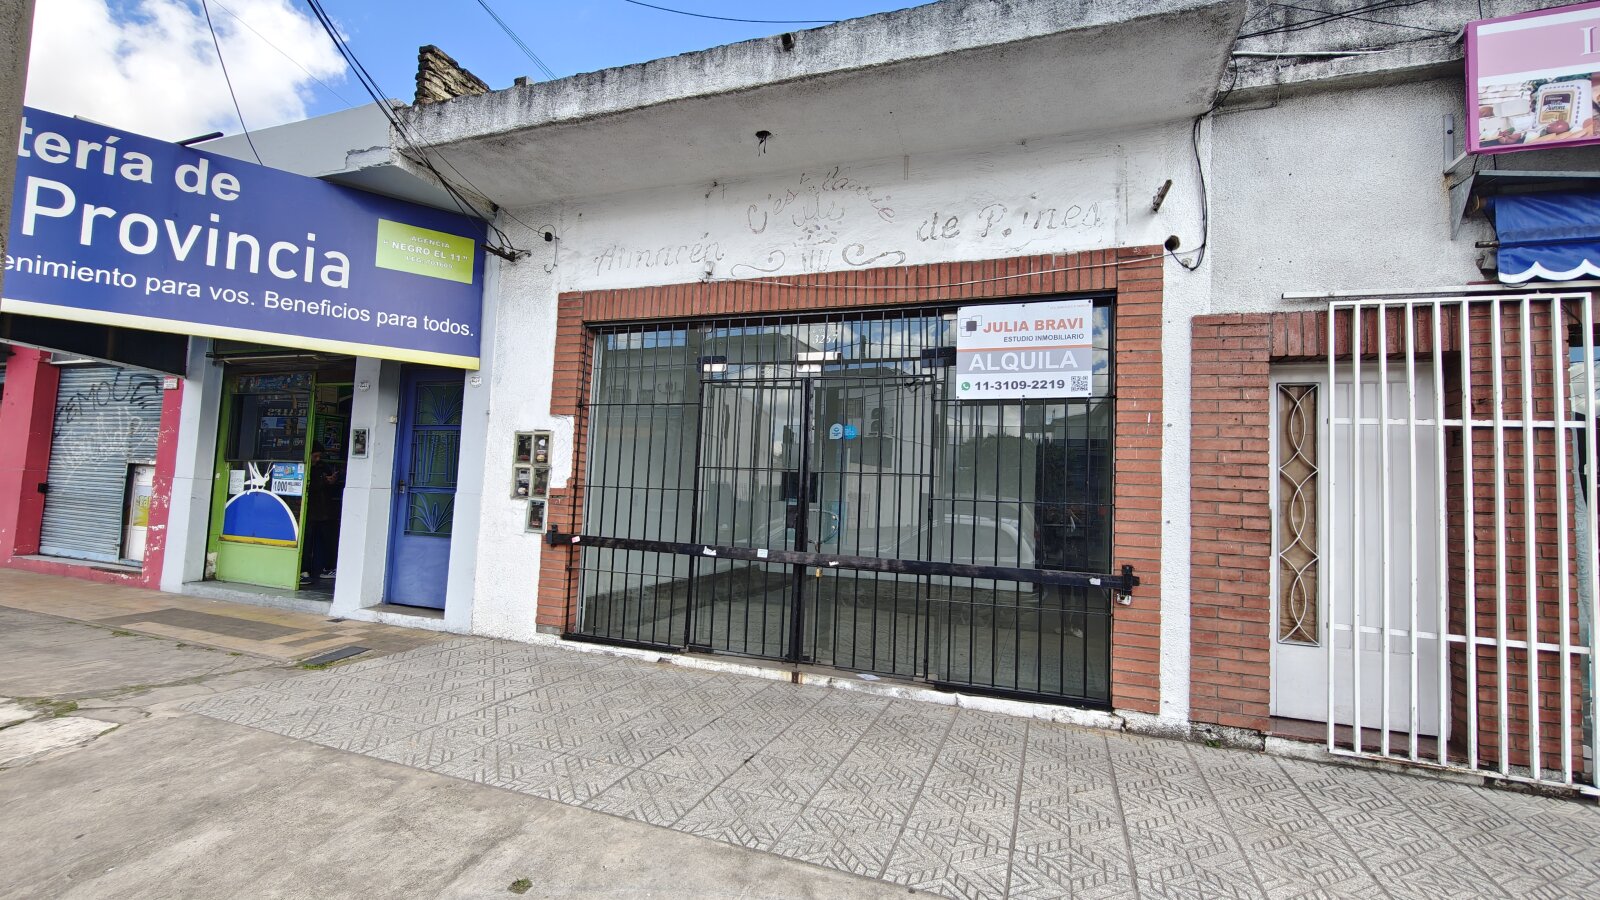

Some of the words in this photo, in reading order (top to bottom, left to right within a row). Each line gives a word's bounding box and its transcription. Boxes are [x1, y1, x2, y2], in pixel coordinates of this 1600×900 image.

[174, 158, 241, 201] de
[21, 176, 350, 288] Provincia
[916, 212, 960, 242] de
[411, 236, 450, 248] AGENCIA
[434, 250, 447, 260] EL
[145, 276, 201, 298] para
[209, 286, 255, 306] vos.
[264, 290, 371, 322] Beneficios
[376, 311, 418, 329] para
[423, 315, 474, 337] todos.
[983, 321, 1029, 333] JULIA
[1034, 317, 1084, 330] BRAVI
[1035, 333, 1085, 341] INMOBILIARIO
[968, 350, 1079, 372] ALQUILA
[974, 379, 1066, 391] 11-3109-2219
